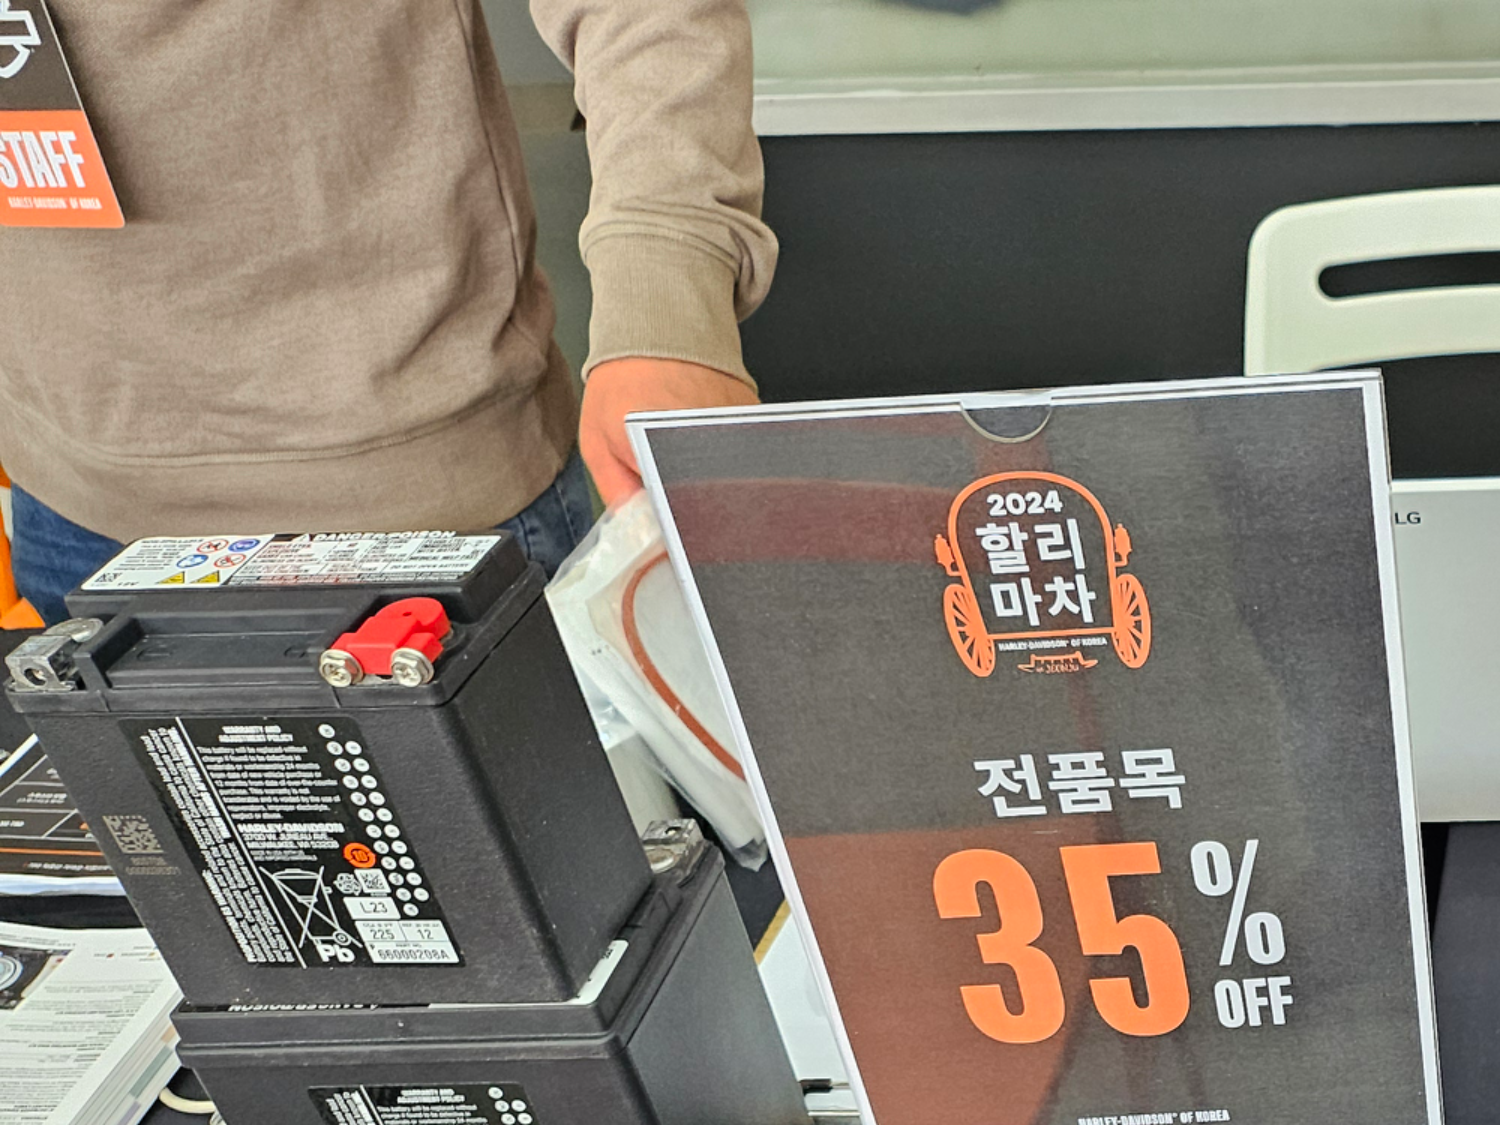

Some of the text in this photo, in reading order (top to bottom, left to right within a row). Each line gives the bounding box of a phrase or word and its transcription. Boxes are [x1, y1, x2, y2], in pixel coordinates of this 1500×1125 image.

[986, 490, 1063, 517] 2024
[1394, 511, 1422, 525] LG
[975, 518, 1086, 575] 할리
[989, 574, 1096, 627] 마차
[974, 748, 1186, 818] 전품목
[360, 902, 387, 913] L23
[370, 929, 395, 940] 225
[417, 929, 433, 940] 12
[316, 944, 355, 962] Pb
[1213, 977, 1294, 1030] OFF
[1180, 1111, 1194, 1124] OF
[1195, 1109, 1230, 1122] KOREA
